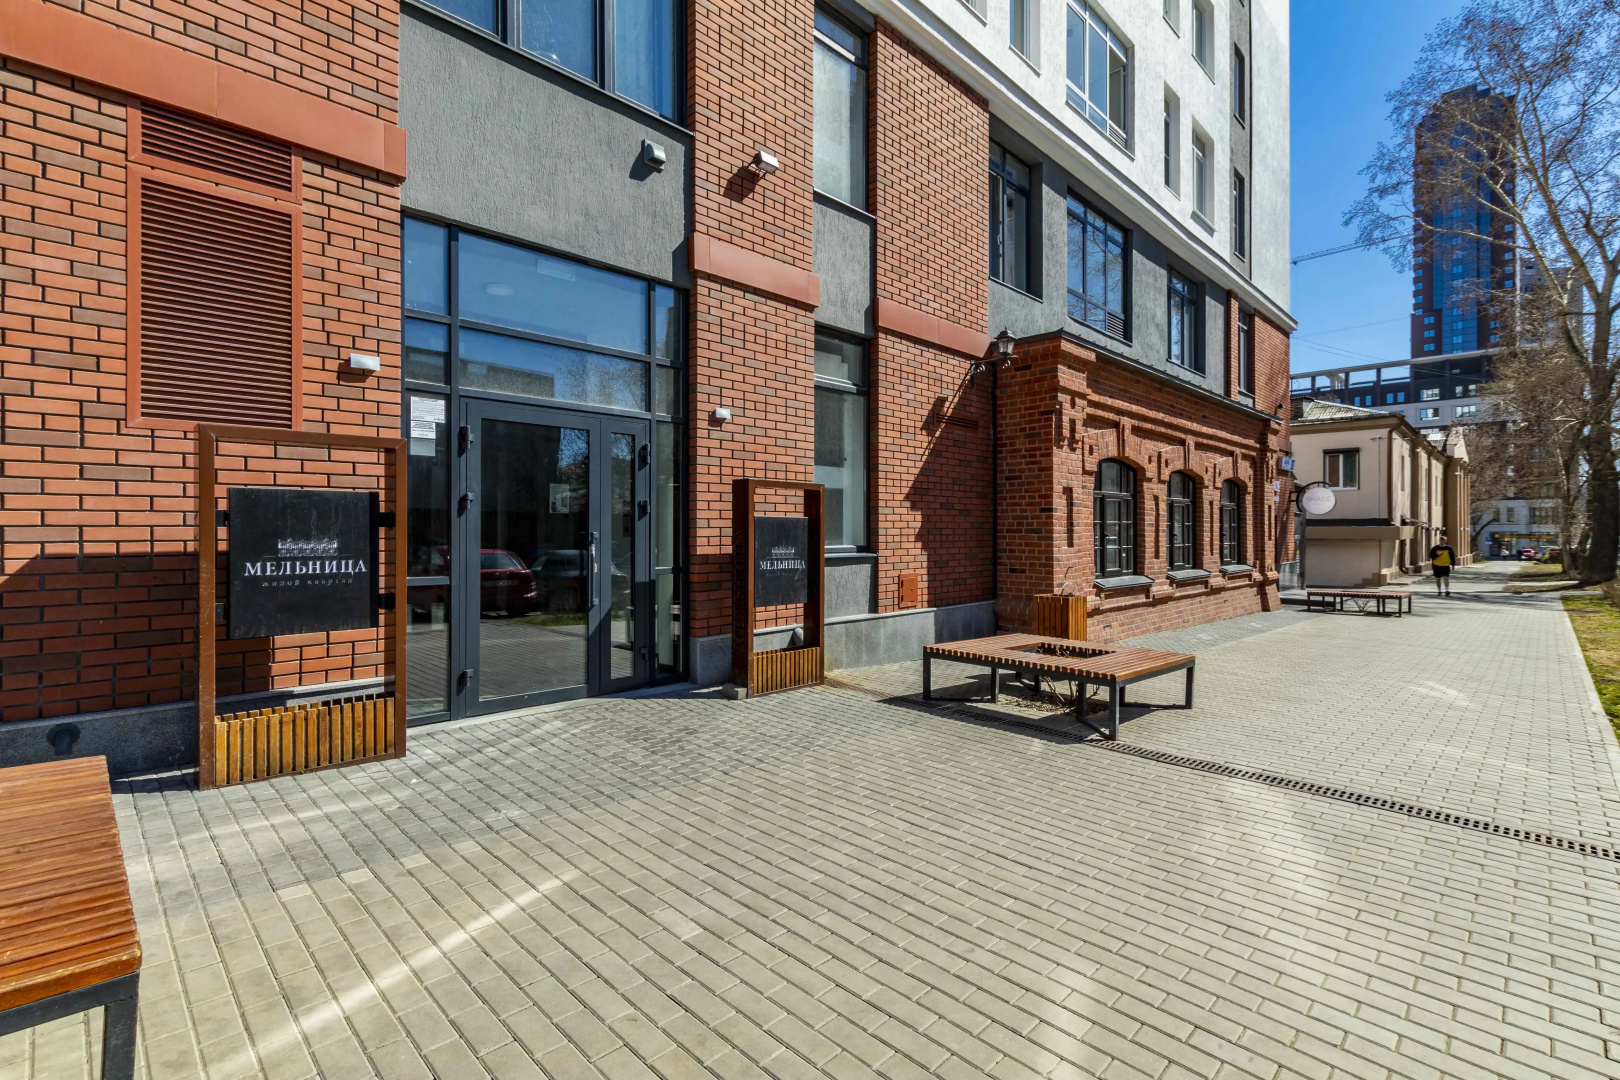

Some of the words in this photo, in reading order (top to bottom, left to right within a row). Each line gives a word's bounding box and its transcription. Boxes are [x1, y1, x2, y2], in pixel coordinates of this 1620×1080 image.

[244, 559, 367, 577] МЕЛЬНИЦА
[759, 560, 806, 570] МЕЛЬНИЦА
[261, 579, 300, 587] жилой
